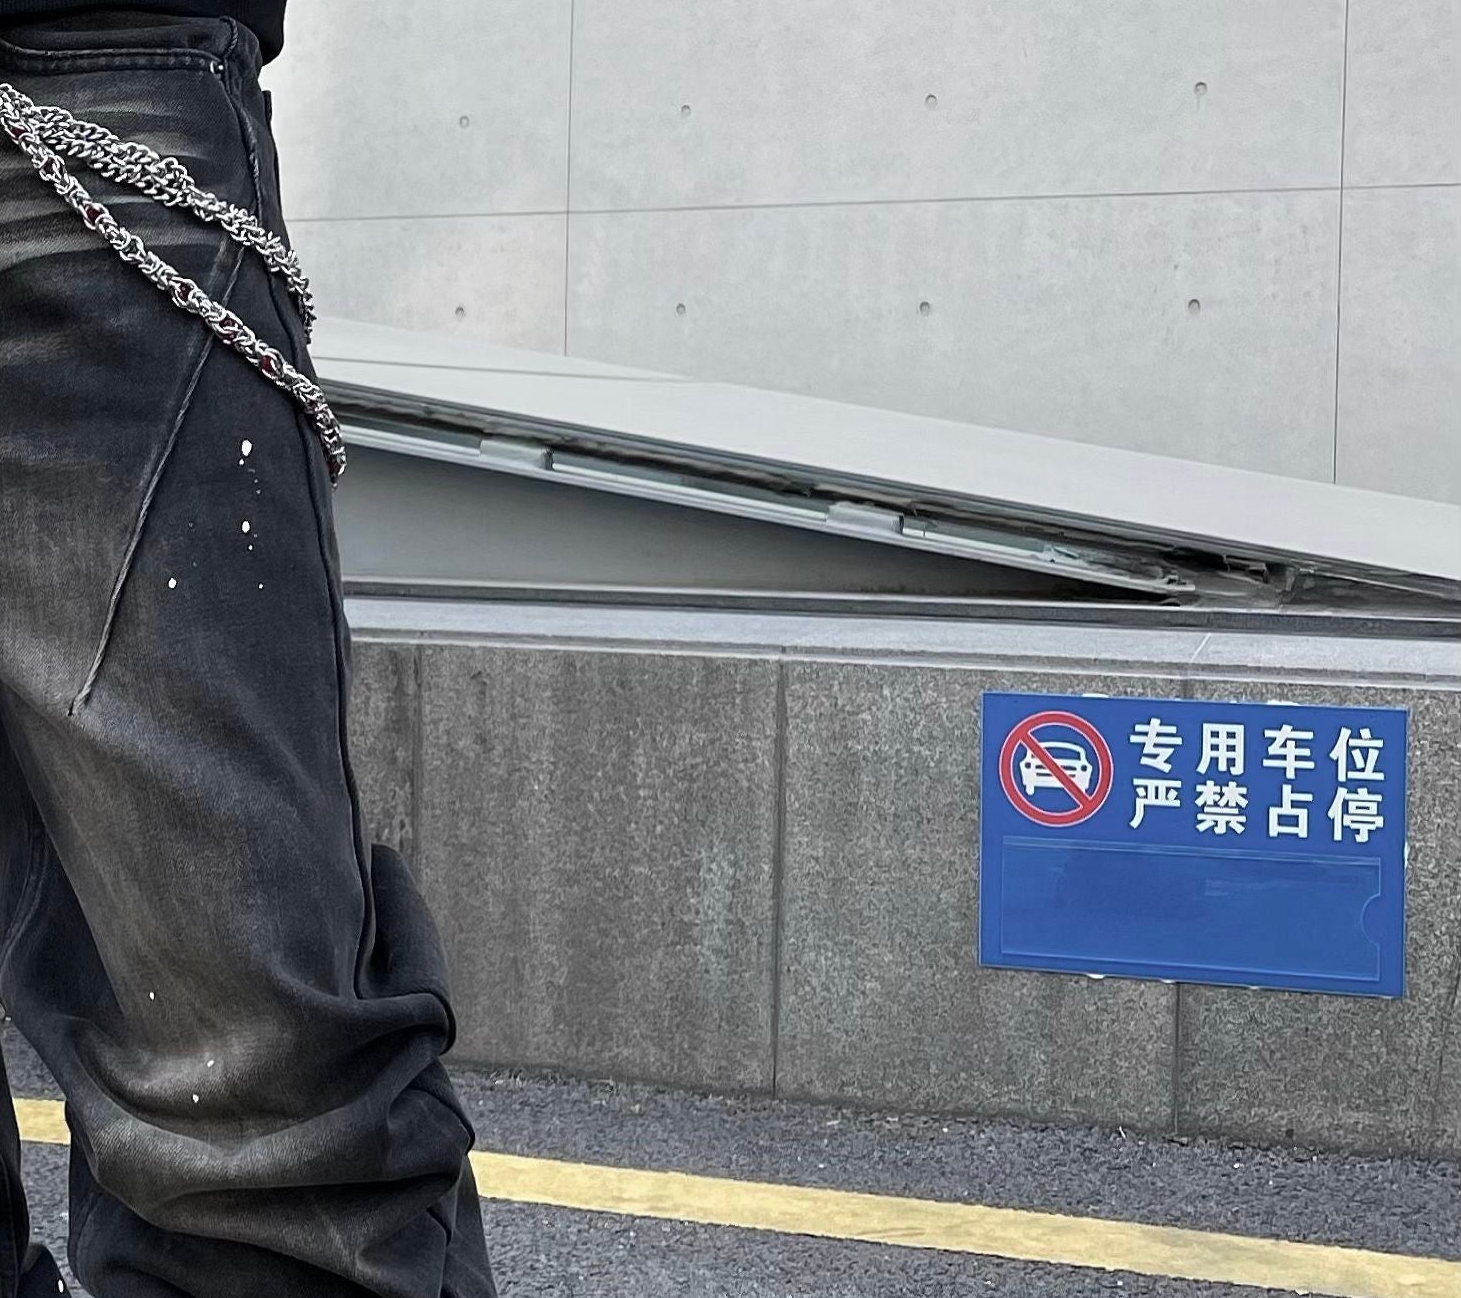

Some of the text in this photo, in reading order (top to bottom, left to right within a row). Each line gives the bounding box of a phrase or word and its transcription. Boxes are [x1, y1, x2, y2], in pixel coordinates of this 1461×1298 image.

[1129, 717, 1385, 782] 专用车位
[1129, 777, 1385, 843] 严禁占停
